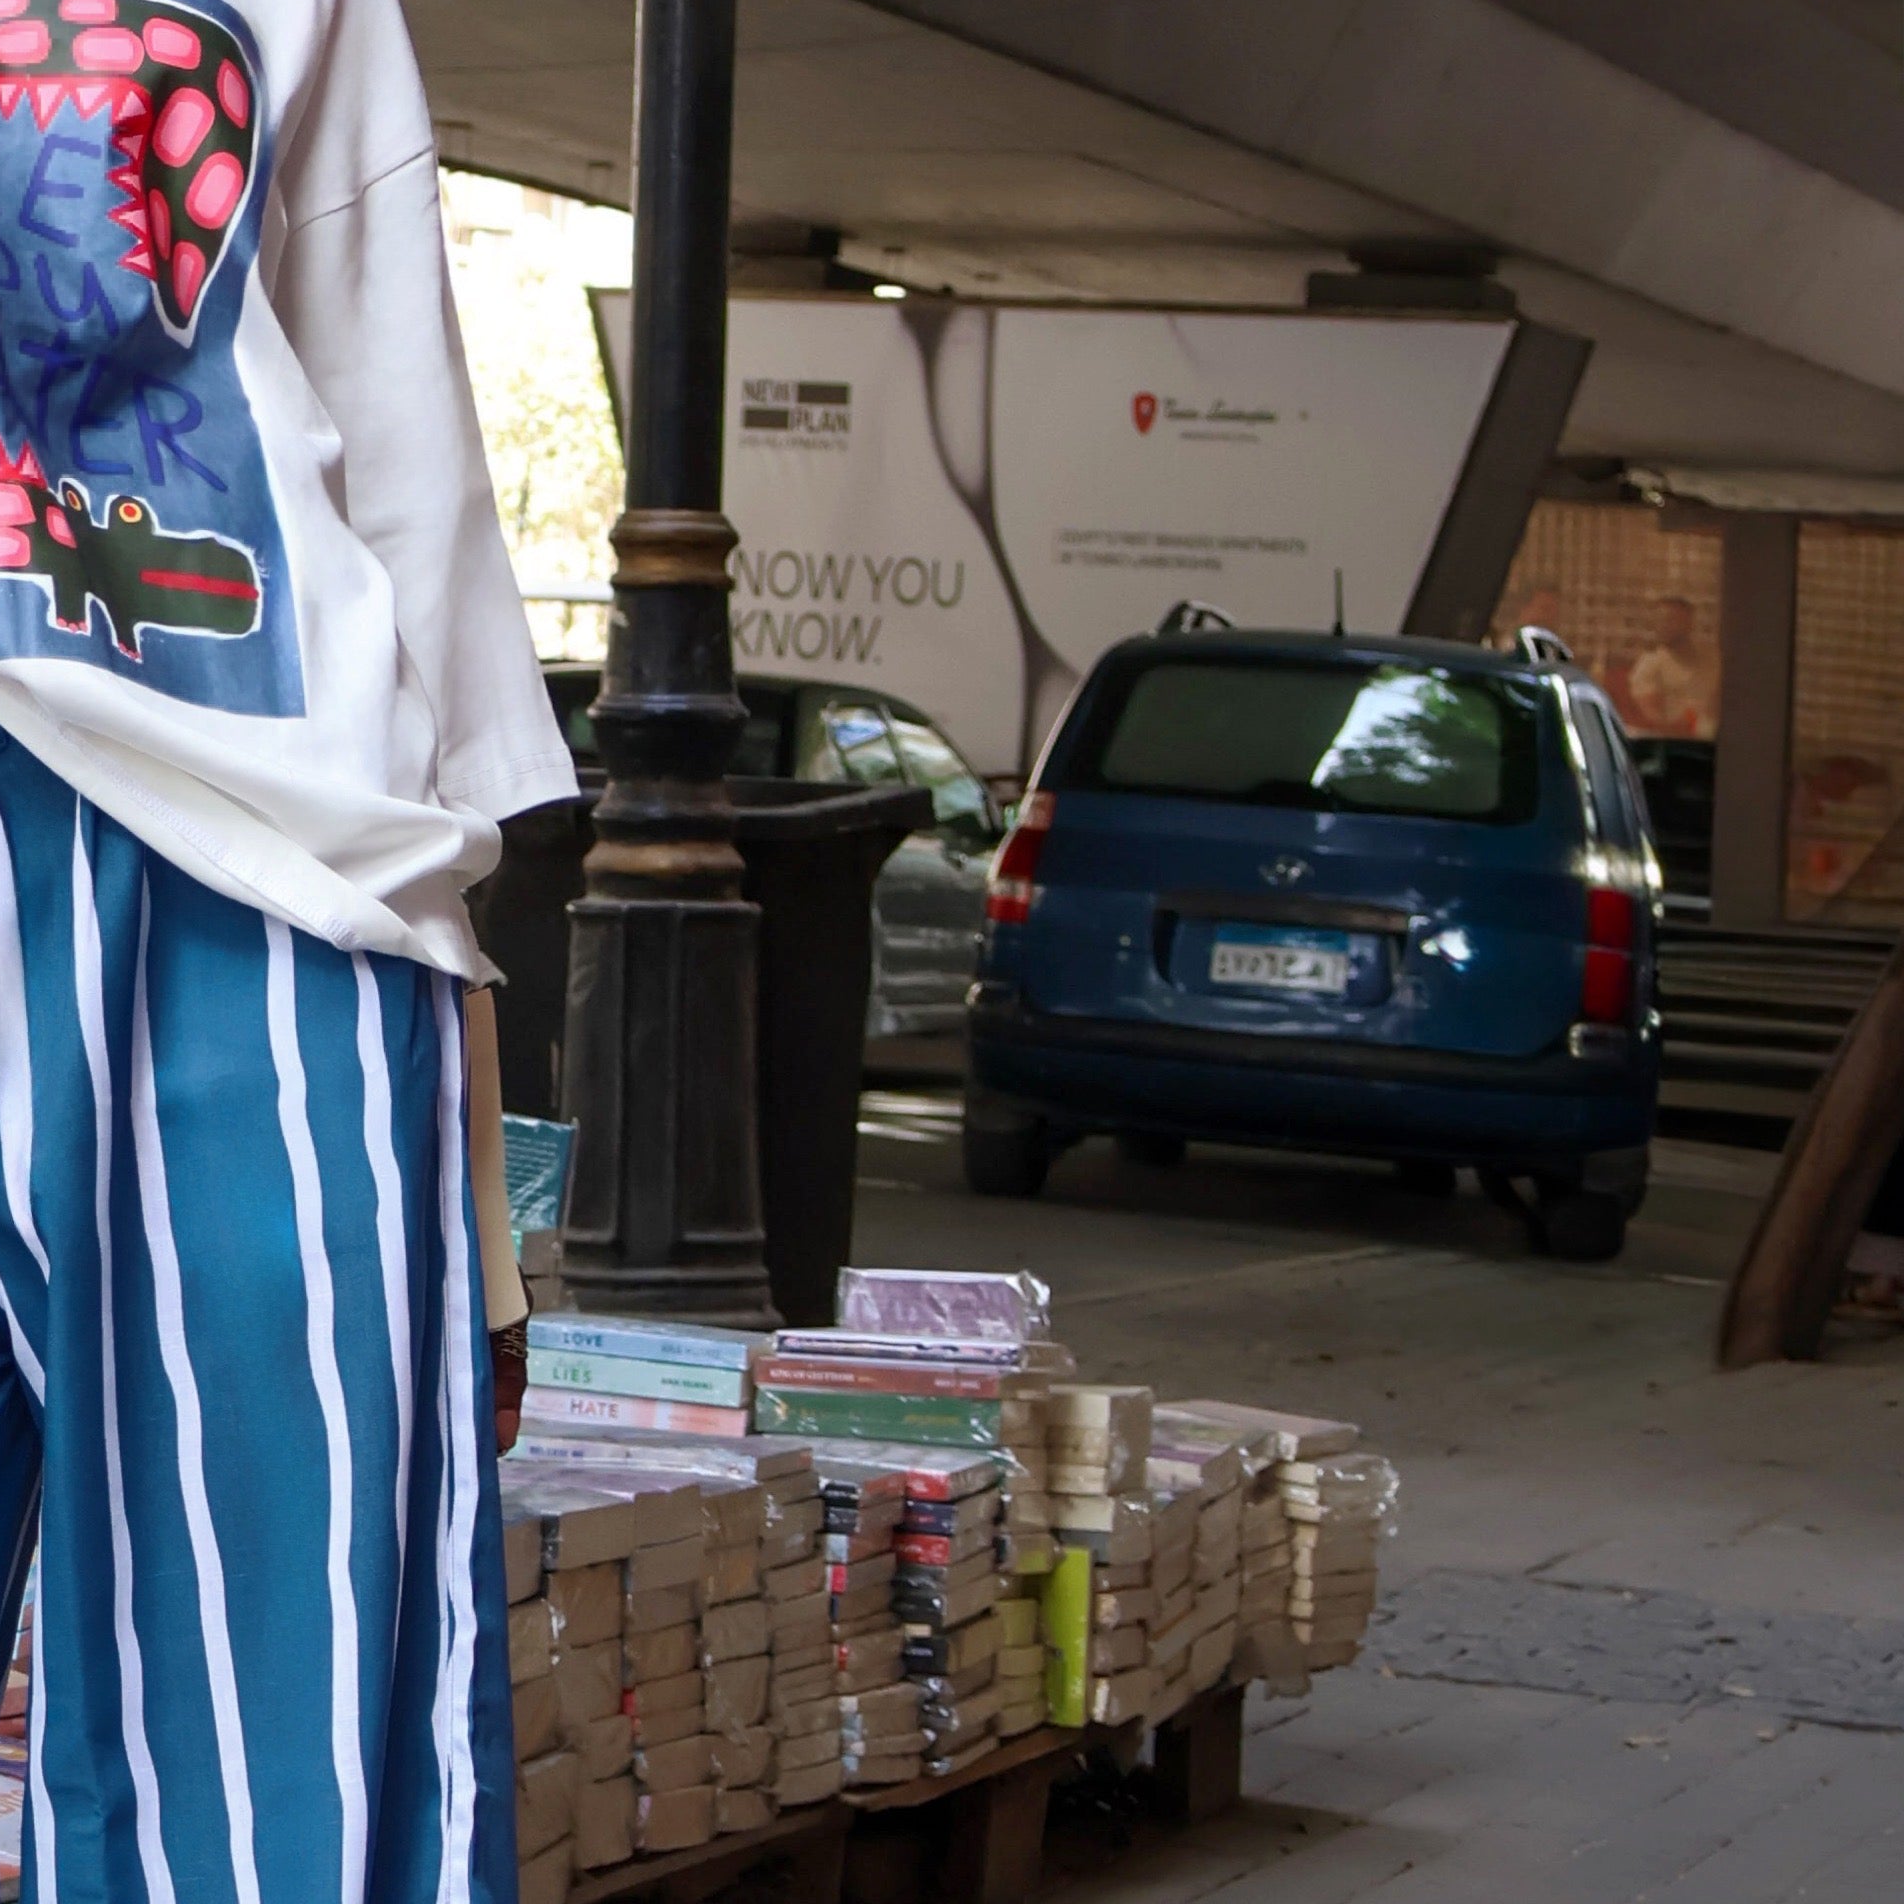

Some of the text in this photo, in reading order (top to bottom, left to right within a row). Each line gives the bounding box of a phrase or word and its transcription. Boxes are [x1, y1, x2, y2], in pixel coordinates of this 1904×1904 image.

[791, 409, 850, 434] PLAN
[862, 553, 966, 609] YOU
[562, 1331, 604, 1348] LOVE
[552, 1366, 593, 1384] LIES
[569, 1398, 620, 1420] HATE
